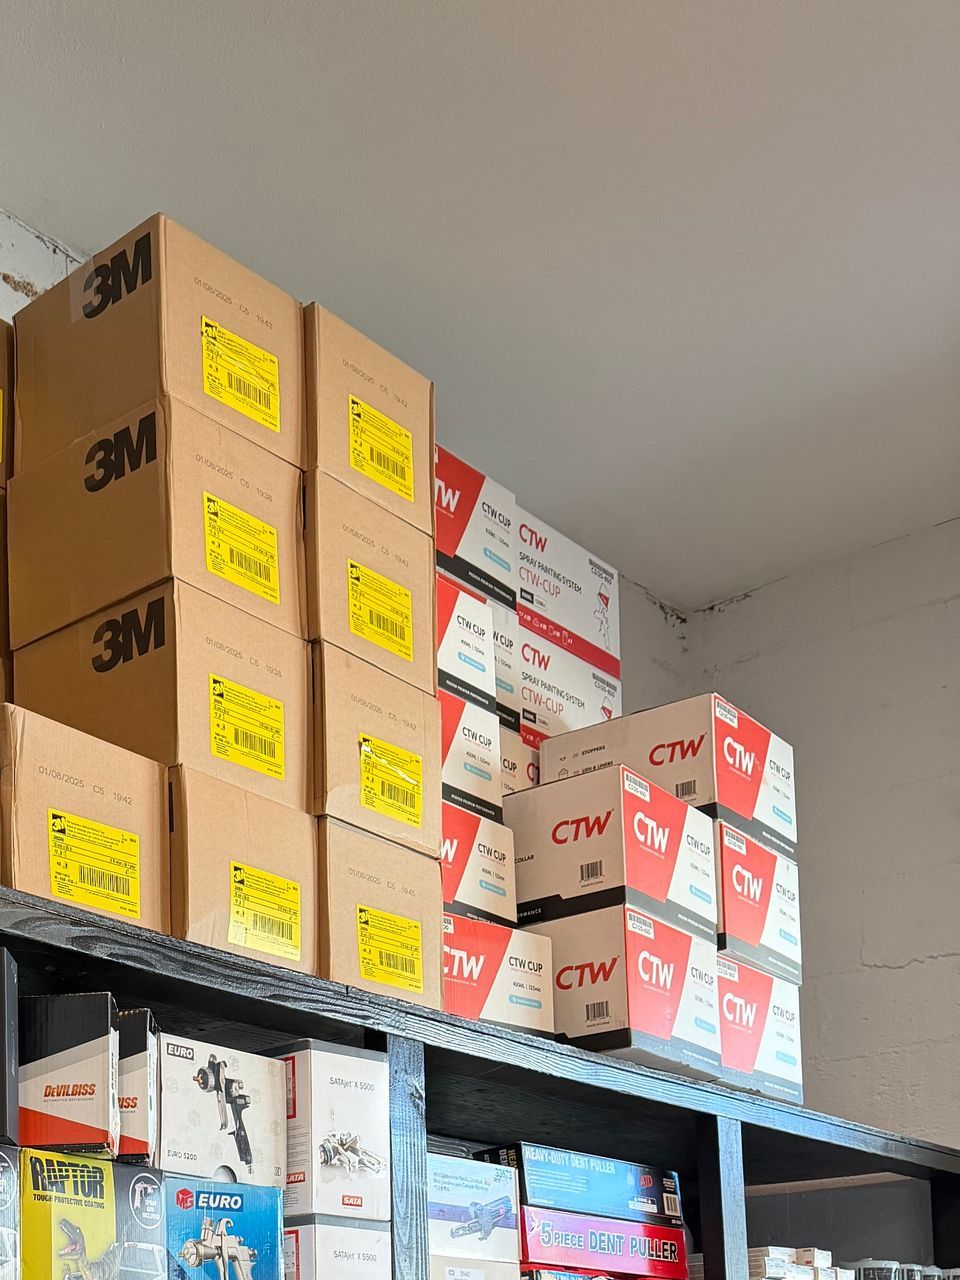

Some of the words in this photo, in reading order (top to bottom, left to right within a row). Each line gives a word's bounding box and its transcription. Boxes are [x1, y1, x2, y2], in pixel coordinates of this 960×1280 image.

[82, 231, 153, 319] 3M
[84, 411, 157, 493] 3M
[518, 522, 548, 554] CTW
[518, 551, 536, 570] SPRAY
[536, 559, 561, 584] PAINTING
[562, 574, 582, 595] SYSTEM
[518, 566, 561, 600] CTW-CUP
[92, 596, 166, 674] 3M
[521, 643, 551, 671] CTW
[648, 733, 708, 767] CTW
[724, 736, 756, 776] CTW
[93, 784, 105, 795] C5
[551, 810, 614, 845] CTW
[633, 811, 671, 853] CTW
[509, 955, 525, 968] CTW
[526, 959, 543, 974] CUP
[637, 949, 675, 991] CTW
[167, 1043, 195, 1060] EURO
[359, 1081, 375, 1092] 5500
[29, 1154, 106, 1200] RAPTOR
[198, 1193, 242, 1210] EURO
[343, 1196, 363, 1206] SATA
[540, 1221, 552, 1247] 5
[554, 1231, 584, 1248] PIECE
[588, 1229, 624, 1255] DENT
[629, 1236, 679, 1263] PULLER
